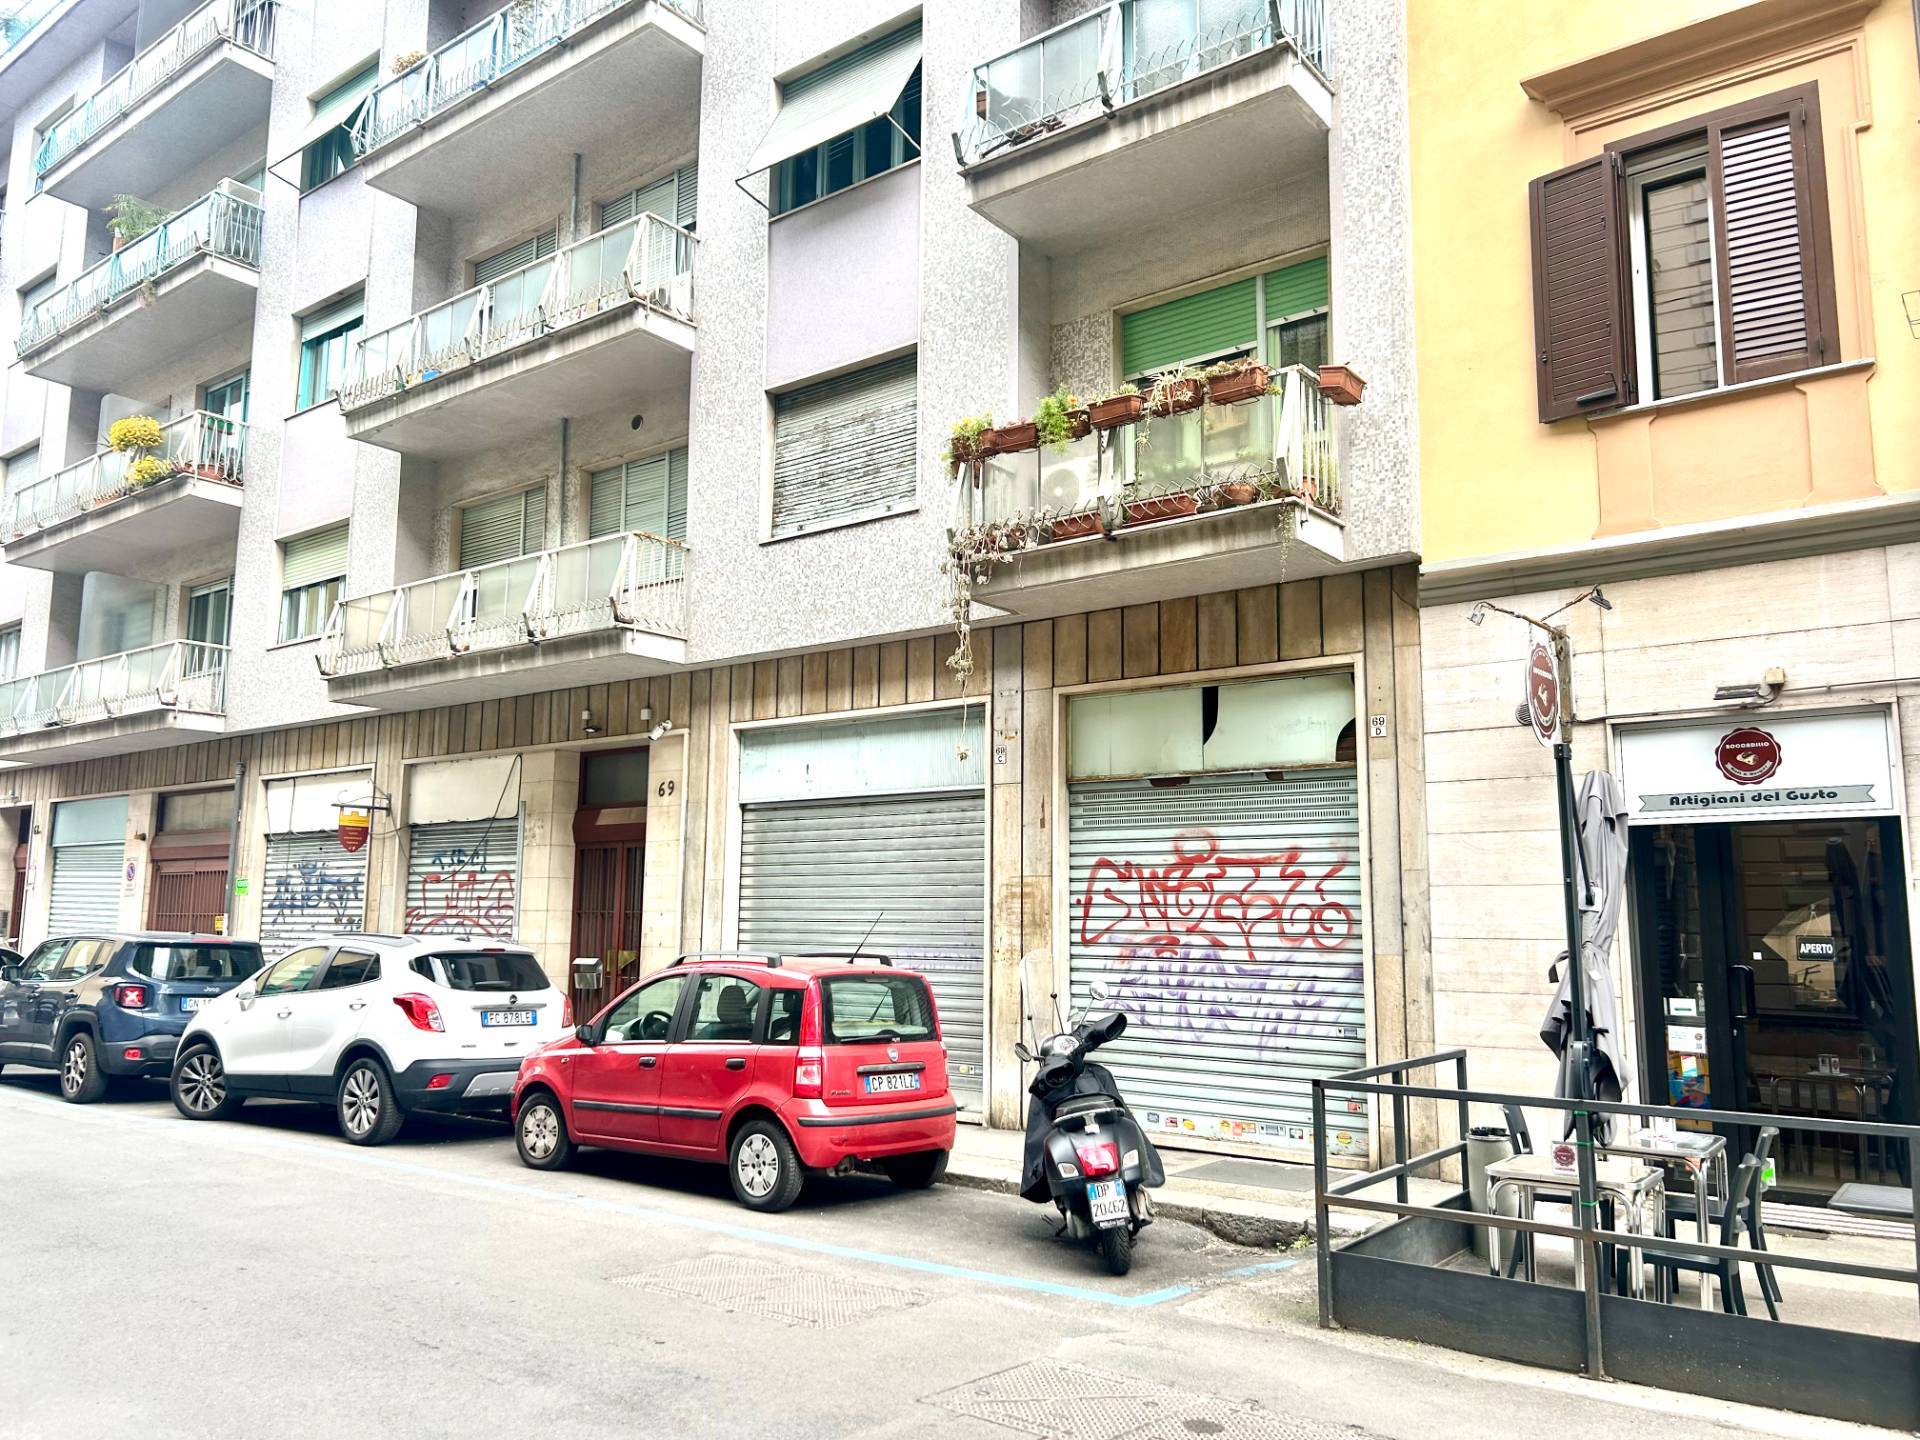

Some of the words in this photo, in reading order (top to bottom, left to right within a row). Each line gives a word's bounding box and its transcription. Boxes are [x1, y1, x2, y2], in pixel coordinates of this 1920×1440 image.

[1372, 716, 1385, 726] 69
[1375, 727, 1382, 736] D
[997, 755, 1003, 763] C
[658, 780, 675, 797] 69
[1669, 793, 1745, 807] Artigiani
[1751, 791, 1780, 802] del
[1786, 790, 1838, 801] Gusto
[1800, 943, 1833, 954] APERTO
[489, 1012, 500, 1024] FC
[503, 1011, 531, 1024] 878LE
[871, 1076, 884, 1091] CP
[886, 1074, 915, 1090] 821LZ
[1096, 1184, 1110, 1198] DP
[1092, 1198, 1127, 1218] 20462
